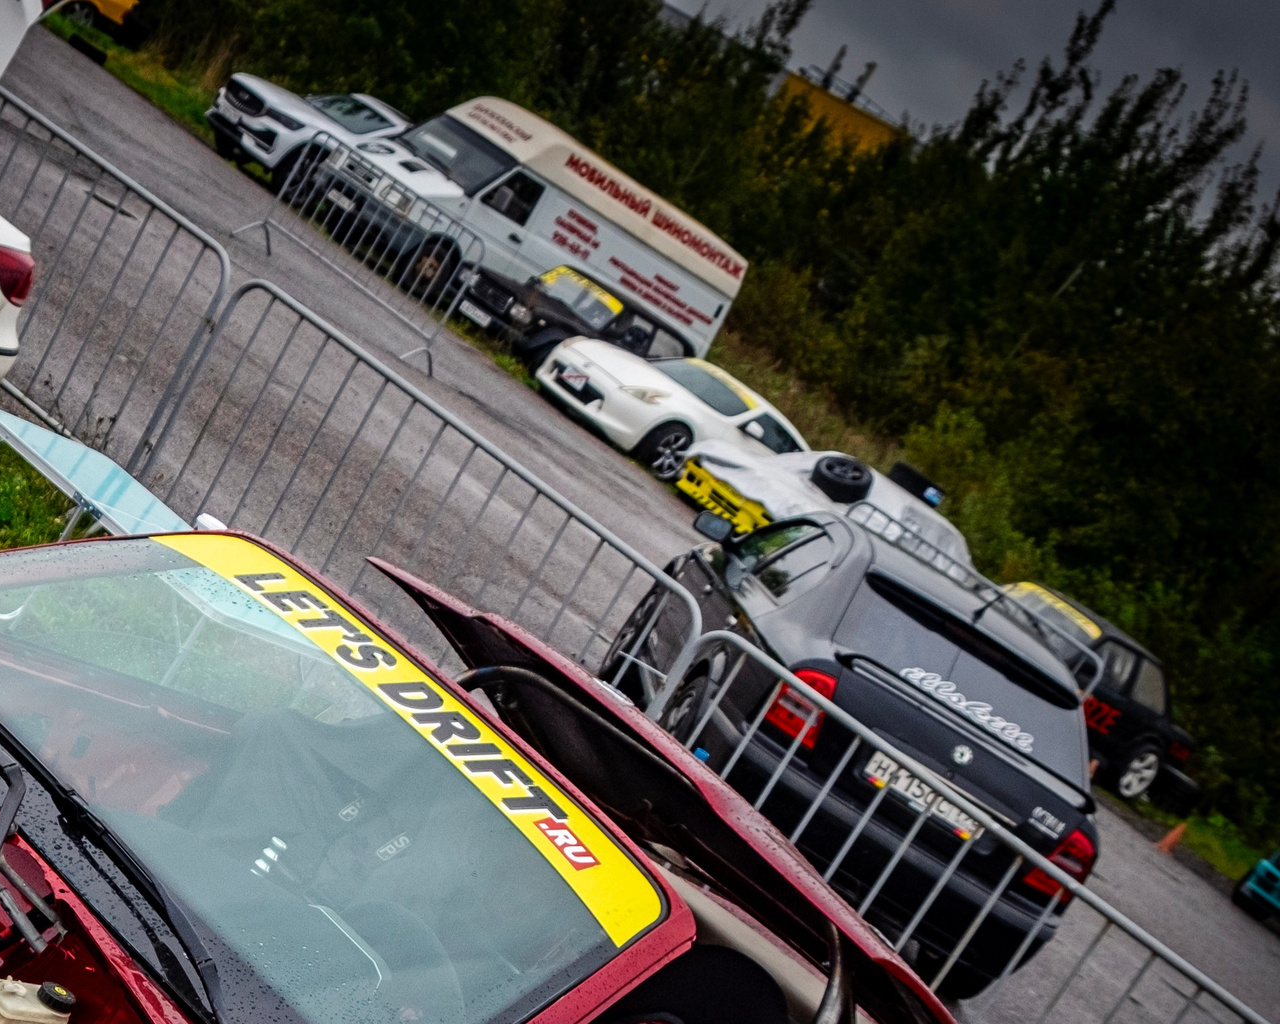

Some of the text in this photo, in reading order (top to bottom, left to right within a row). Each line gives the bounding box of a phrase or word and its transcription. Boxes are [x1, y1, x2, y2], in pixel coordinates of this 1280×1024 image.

[564, 153, 652, 218] МОБИЛЬНЫЙ
[651, 209, 744, 279] ШИНОМОНТАЖ
[232, 572, 398, 672] LET'S
